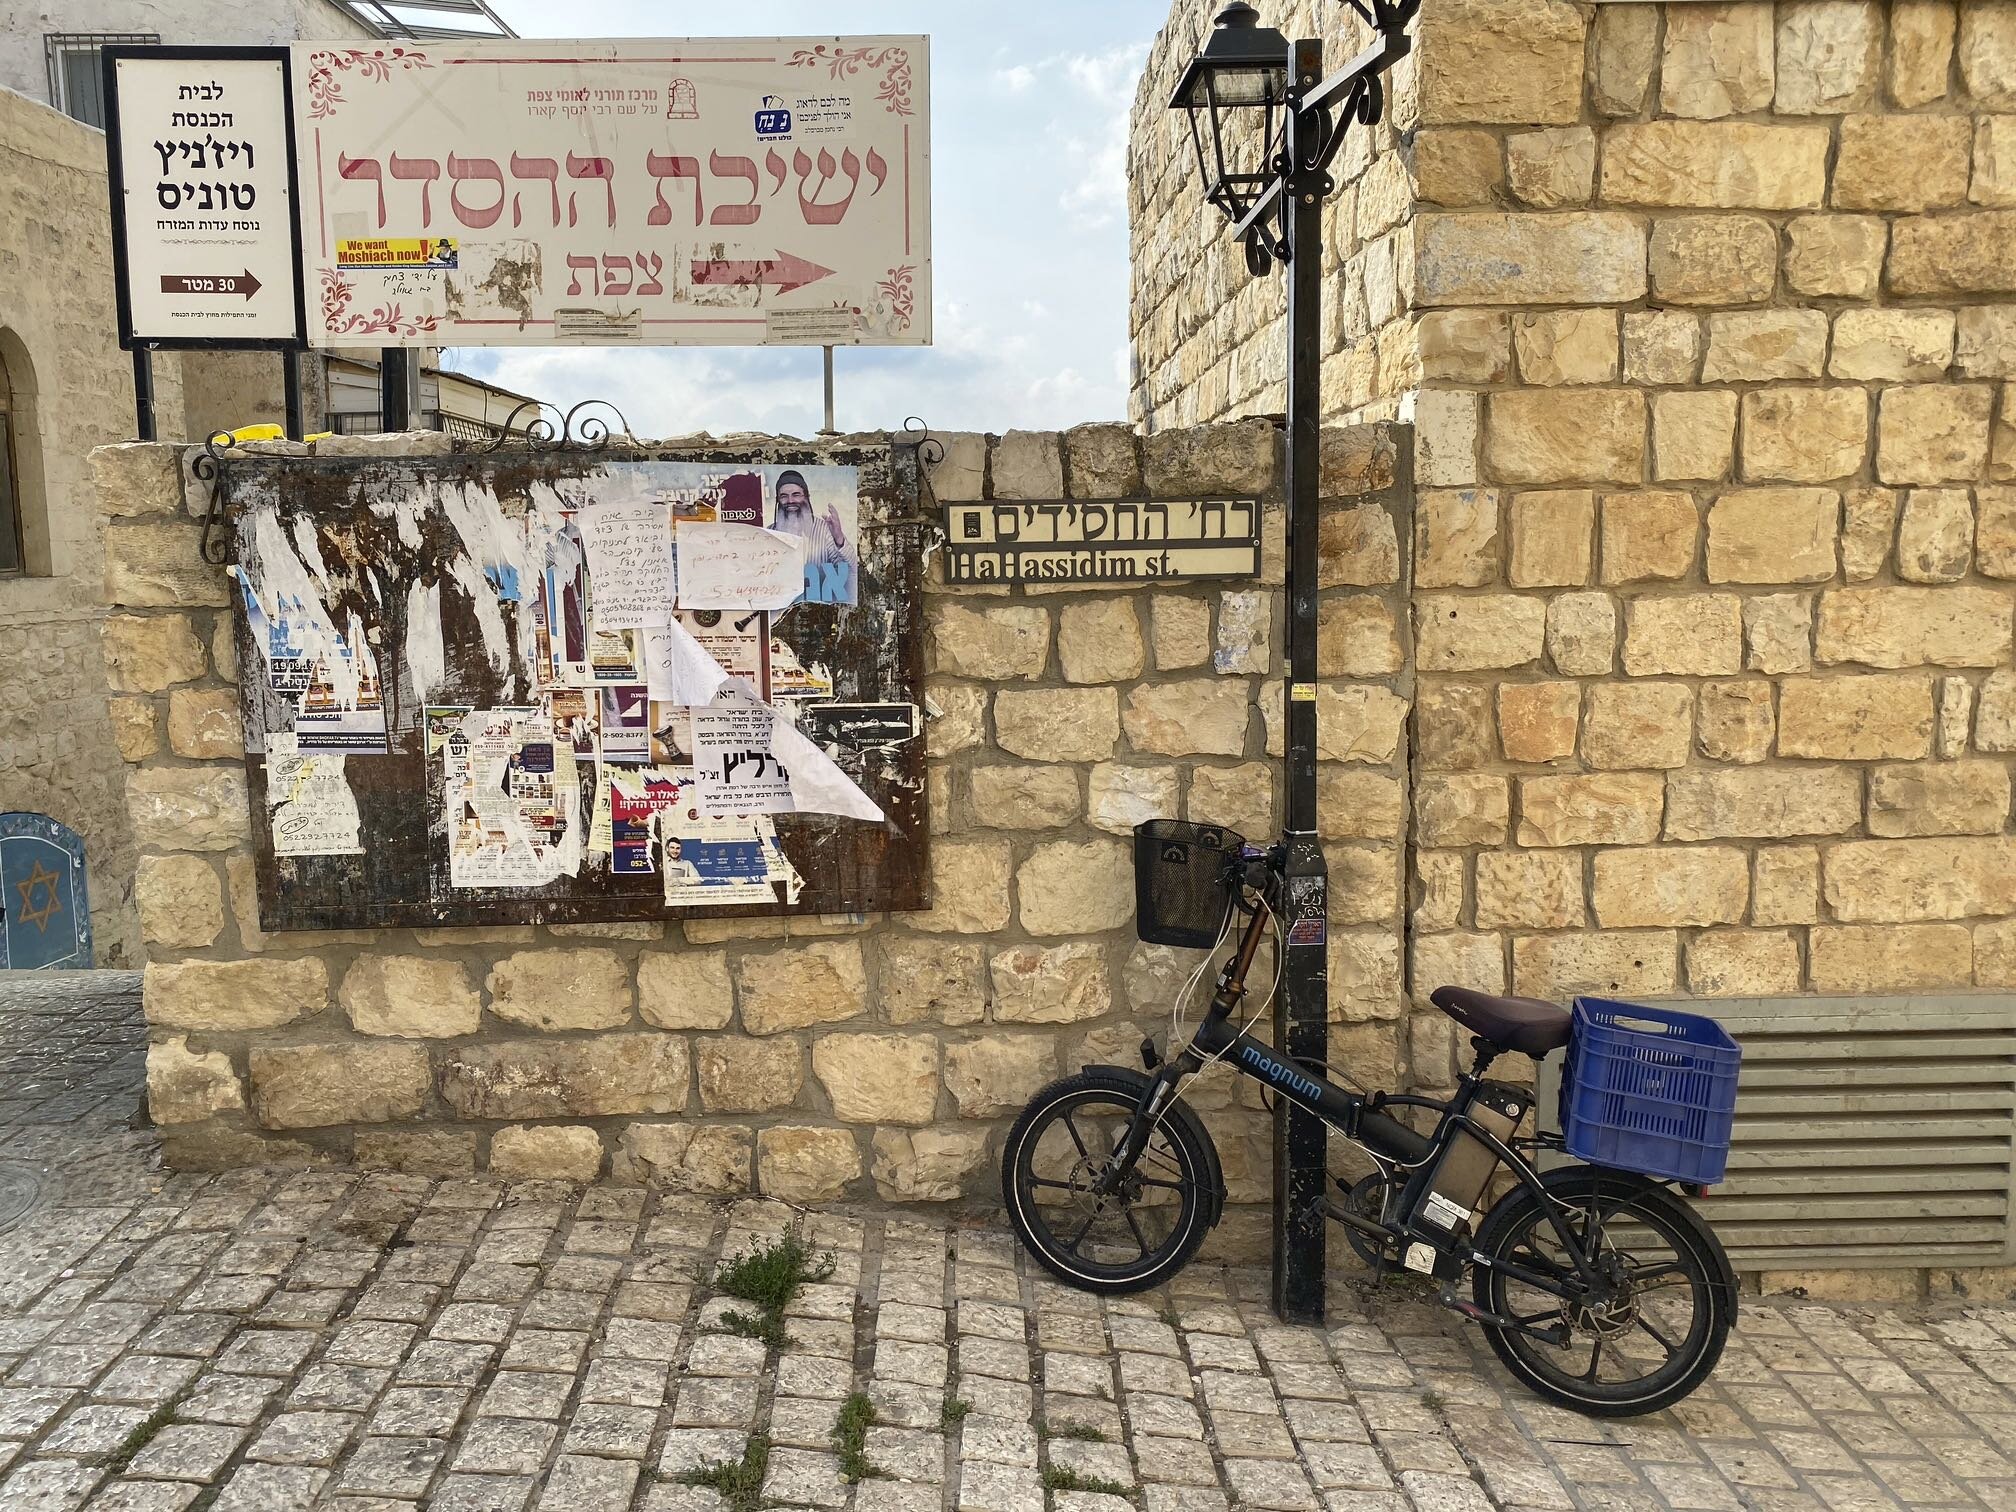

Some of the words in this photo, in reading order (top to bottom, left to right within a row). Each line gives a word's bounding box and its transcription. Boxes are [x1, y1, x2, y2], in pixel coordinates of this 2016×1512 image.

[178, 80, 224, 100] לבית
[527, 90, 553, 102] צפת
[556, 87, 591, 101] לאומי
[594, 90, 624, 101] תורני
[628, 90, 658, 101] מרכז
[820, 94, 836, 107] לכם
[838, 97, 850, 106] מה
[528, 106, 557, 119] קארו
[562, 105, 587, 119] יוסף
[592, 105, 611, 115] רבי
[617, 105, 636, 115] שם
[641, 102, 658, 115] על
[171, 111, 233, 127] הכנסת
[823, 109, 840, 122] הולך
[153, 133, 254, 176] ויז'ניץ
[338, 149, 617, 229] ההסדר
[646, 146, 888, 227] ישיבת
[156, 181, 256, 211] טוניס
[157, 220, 195, 230] המזרח
[198, 221, 228, 231] עדות
[232, 221, 260, 231] נוסח
[347, 241, 364, 251] We
[364, 240, 388, 250] want
[338, 250, 394, 263] Moshiach
[566, 250, 664, 296] צפת
[181, 278, 214, 291] מטר
[218, 279, 236, 291] 30
[992, 503, 1169, 541] החסידים
[1188, 500, 1255, 538] רח'
[951, 550, 1137, 579] HaHassidim
[1145, 550, 1179, 577] st.
[699, 769, 720, 780] זצ"ל
[1242, 1046, 1322, 1101] magnum
